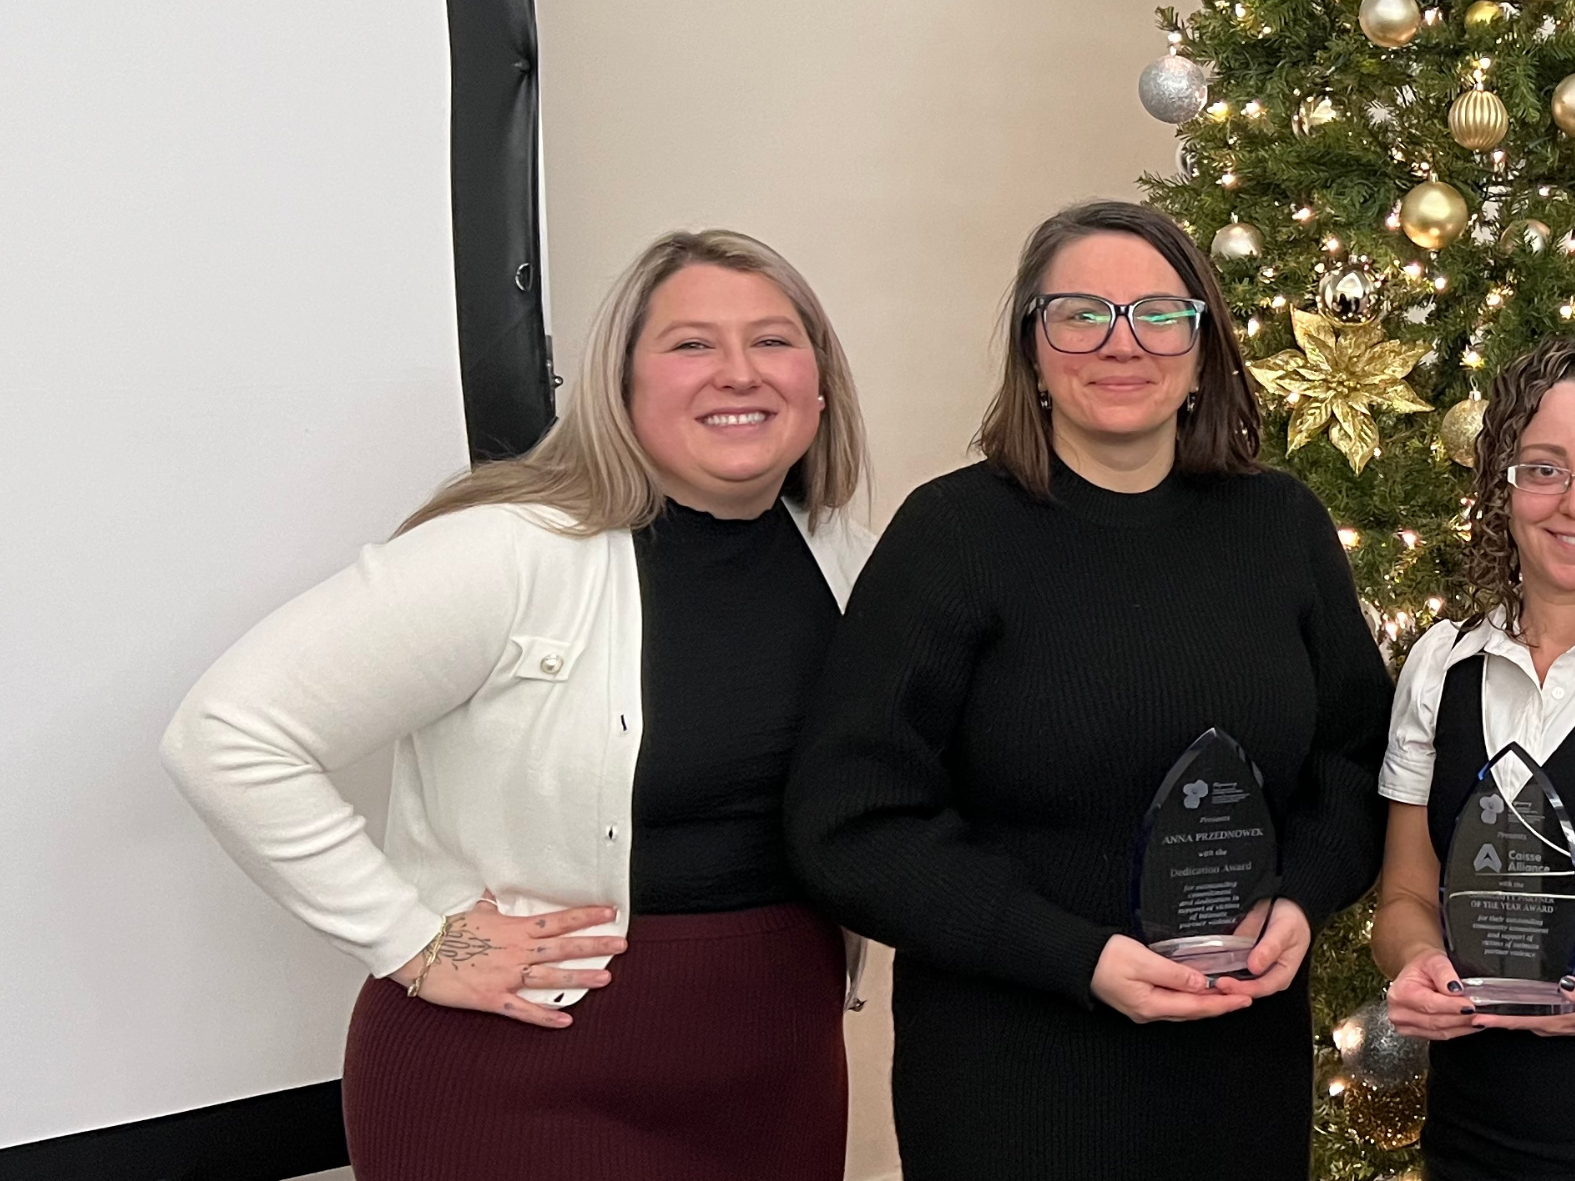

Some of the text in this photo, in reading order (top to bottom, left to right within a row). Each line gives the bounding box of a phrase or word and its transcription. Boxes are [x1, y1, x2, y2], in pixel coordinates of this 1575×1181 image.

[1162, 828, 1264, 845] ANNA PRZEDNOWEK
[1508, 850, 1542, 862] Caisse
[1170, 861, 1252, 877] Dedication Award
[1507, 861, 1551, 872] Alliance
[1470, 900, 1554, 913] OF THE YEAR AWARD
